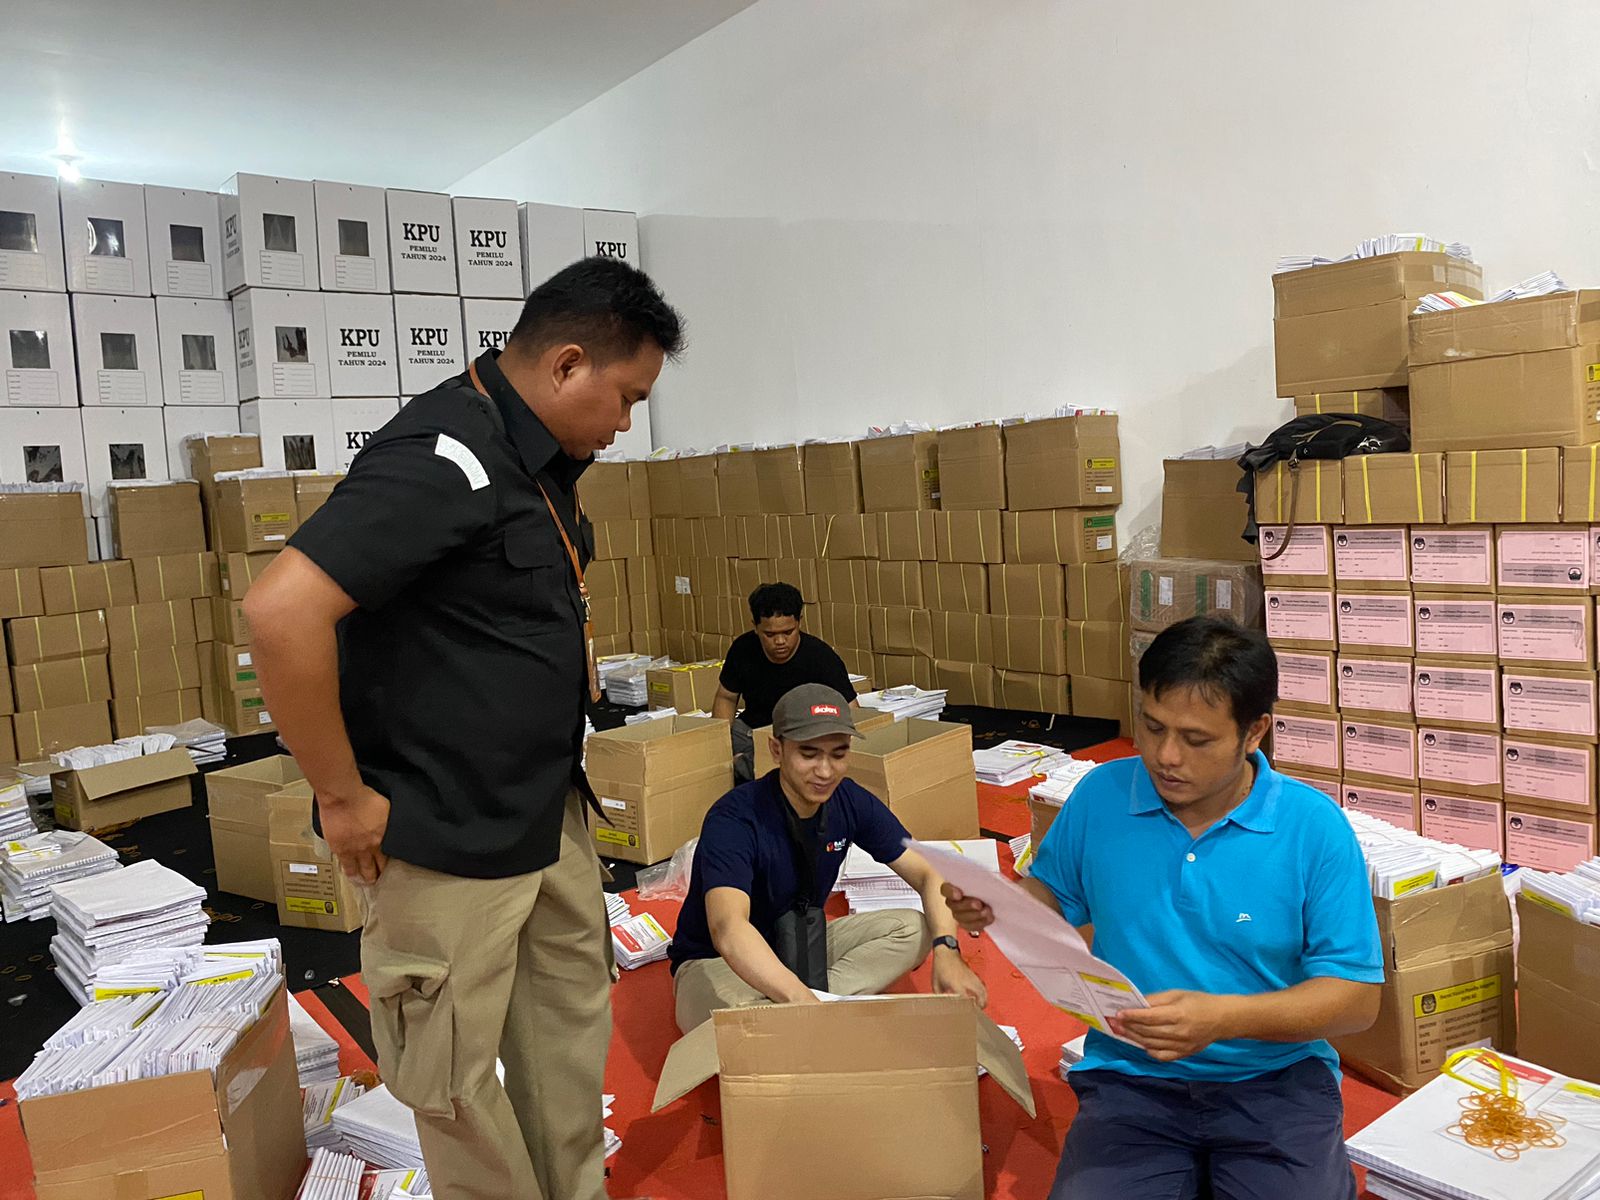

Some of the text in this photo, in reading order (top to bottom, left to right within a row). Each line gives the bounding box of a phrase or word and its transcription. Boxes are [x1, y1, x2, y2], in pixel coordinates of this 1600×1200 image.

[402, 222, 440, 243] KPU
[469, 230, 507, 248] KPU
[401, 252, 447, 262] TAHUN 2024
[409, 245, 438, 253] PEMILU
[476, 251, 504, 259] PEMILU
[595, 241, 627, 259] KPU
[468, 259, 494, 267] TAHUN
[339, 328, 380, 347] KPU
[410, 327, 448, 346] KPU
[345, 431, 376, 449] KP
